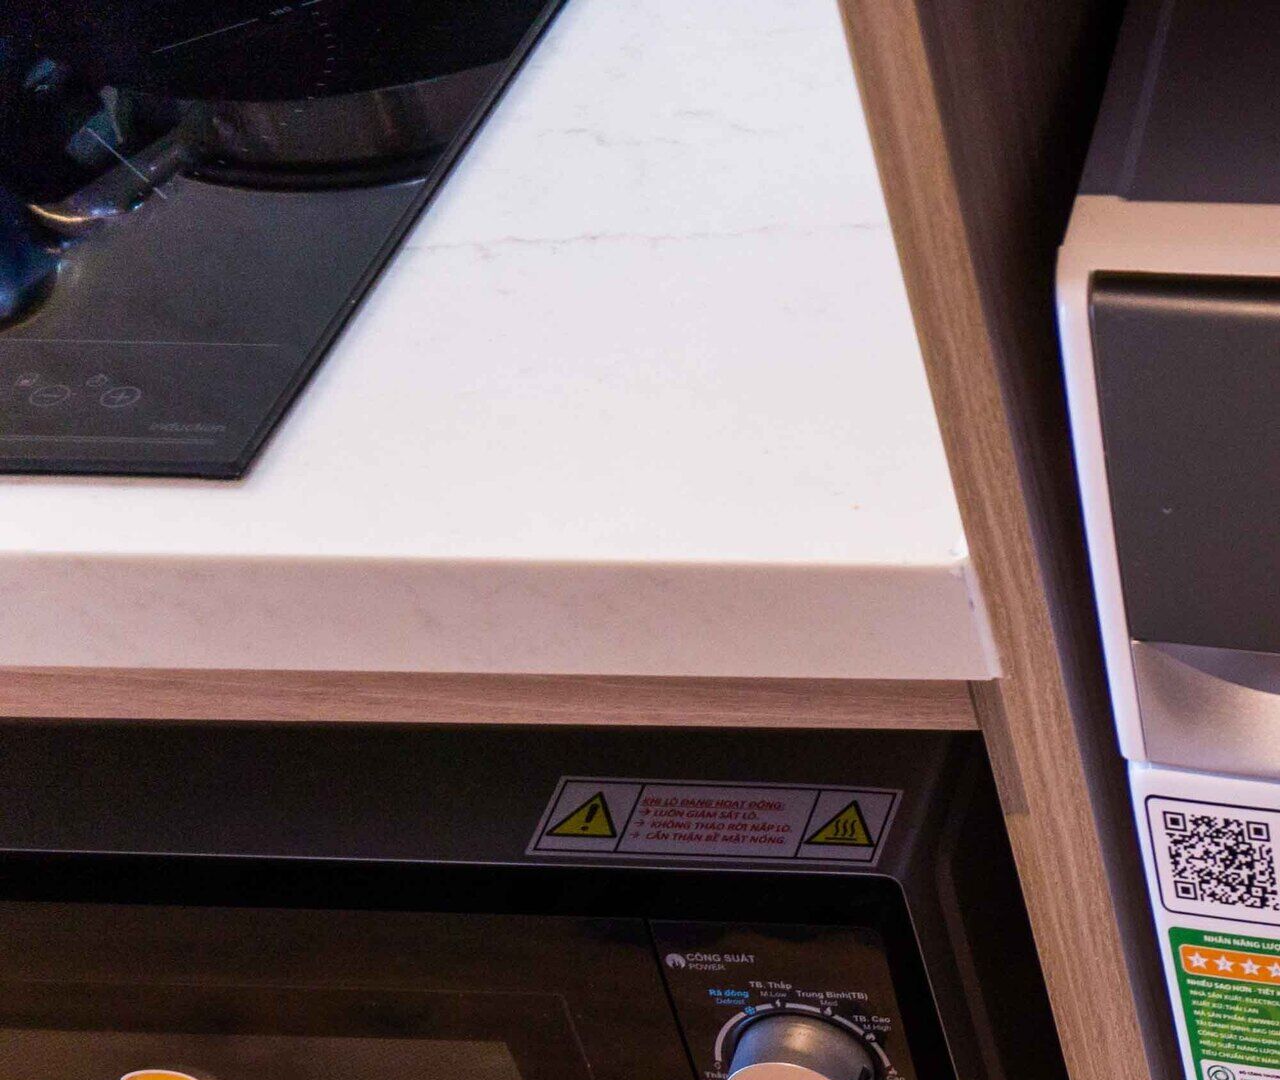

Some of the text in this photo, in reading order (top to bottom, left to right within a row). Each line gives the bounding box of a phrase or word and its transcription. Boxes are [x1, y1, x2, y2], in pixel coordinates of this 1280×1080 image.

[686, 951, 721, 963] CÔNG
[689, 963, 726, 971] POWER
[750, 980, 766, 989] TB.
[796, 990, 824, 1000] Trung
[853, 1014, 891, 1024] TB. Cao
